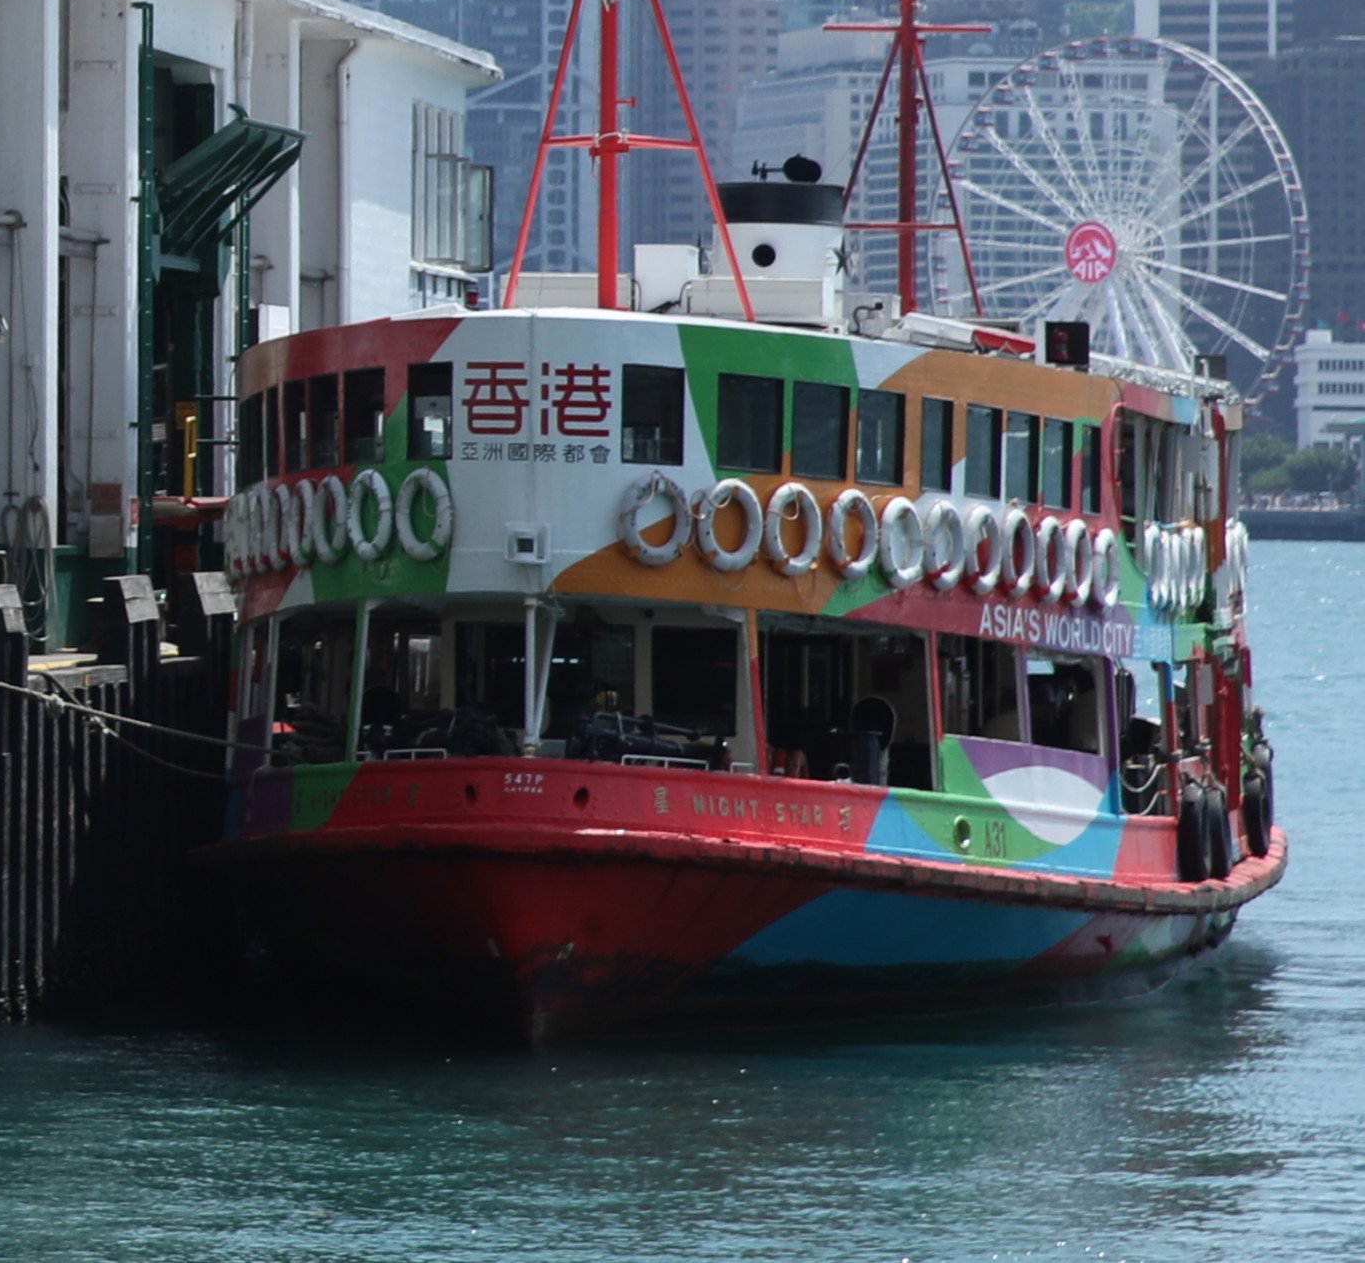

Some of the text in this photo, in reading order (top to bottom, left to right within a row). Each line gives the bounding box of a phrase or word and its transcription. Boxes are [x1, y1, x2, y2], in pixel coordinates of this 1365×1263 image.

[1072, 259, 1110, 280] AIA
[461, 361, 612, 437] 香港
[460, 441, 612, 465] 亞洲國際都會
[979, 603, 1041, 644] ASIA'S
[1044, 612, 1101, 651] WORLD
[1102, 620, 1133, 656] CITY
[692, 793, 759, 821] NIGHT
[775, 801, 825, 826] STAR
[984, 819, 1008, 857] A31
